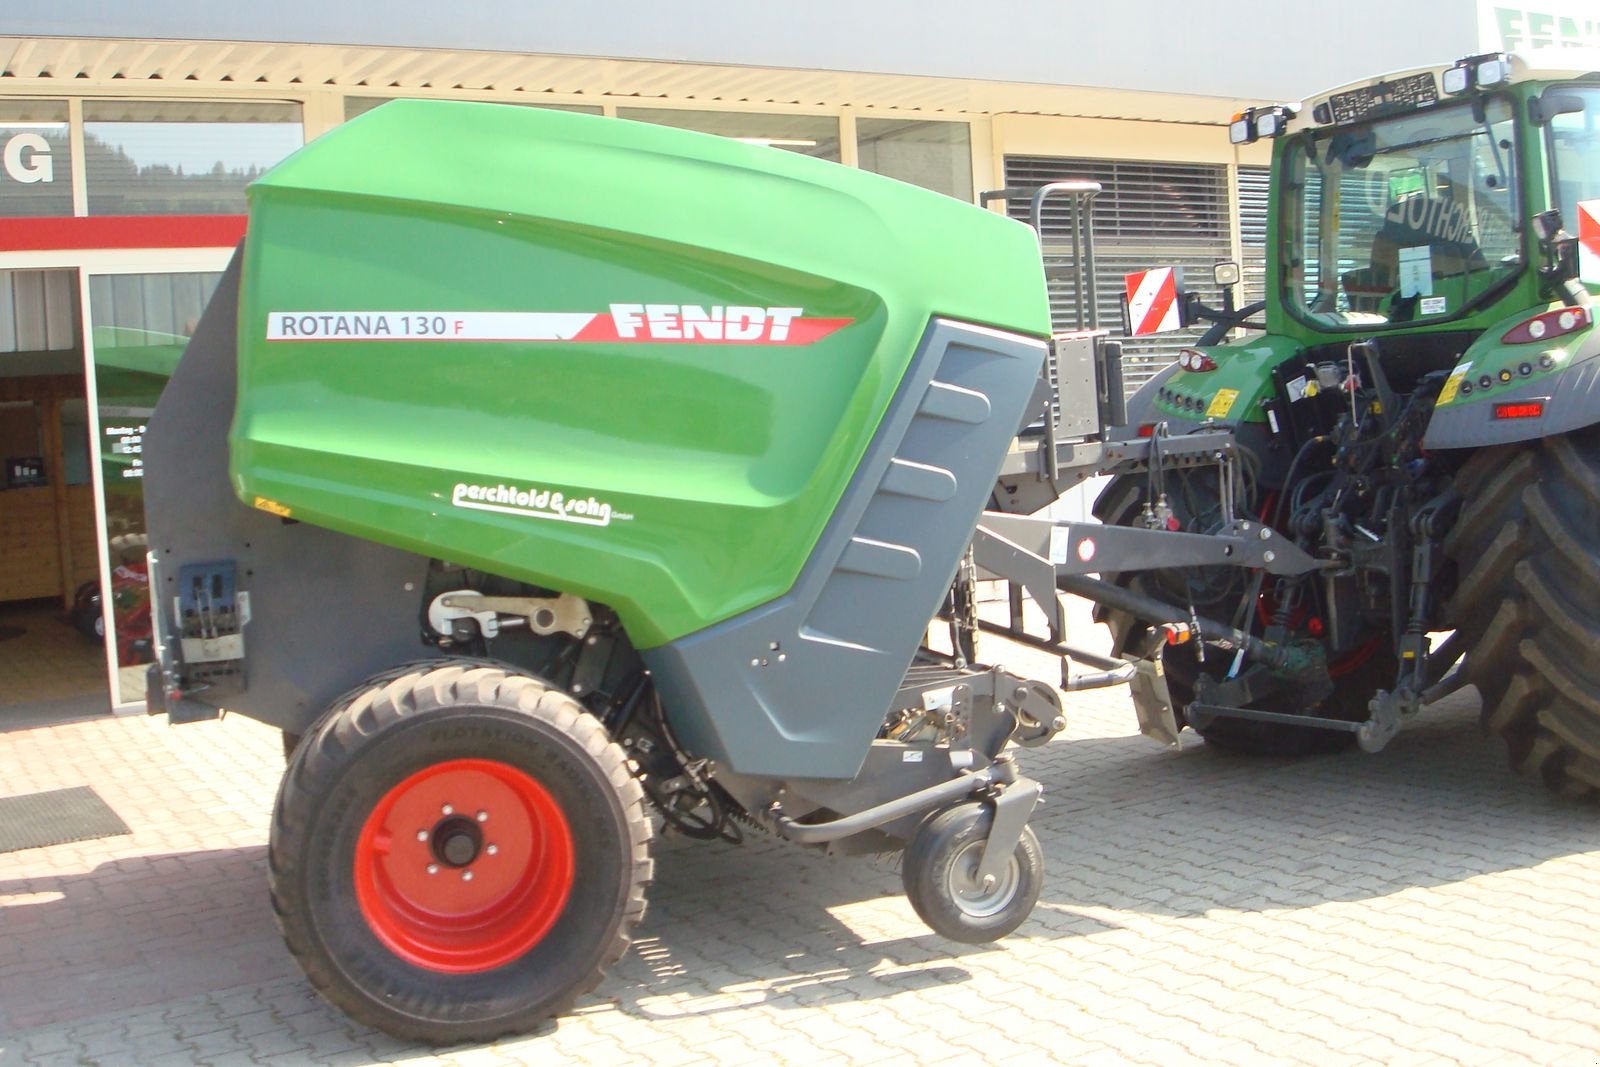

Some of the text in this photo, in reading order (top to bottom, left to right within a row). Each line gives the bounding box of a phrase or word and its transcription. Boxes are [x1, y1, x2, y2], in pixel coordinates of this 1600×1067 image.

[1494, 7, 1600, 52] FEN
[8, 133, 53, 183] G
[281, 315, 463, 335] ROTANA 130 F
[608, 303, 803, 341] FENDT
